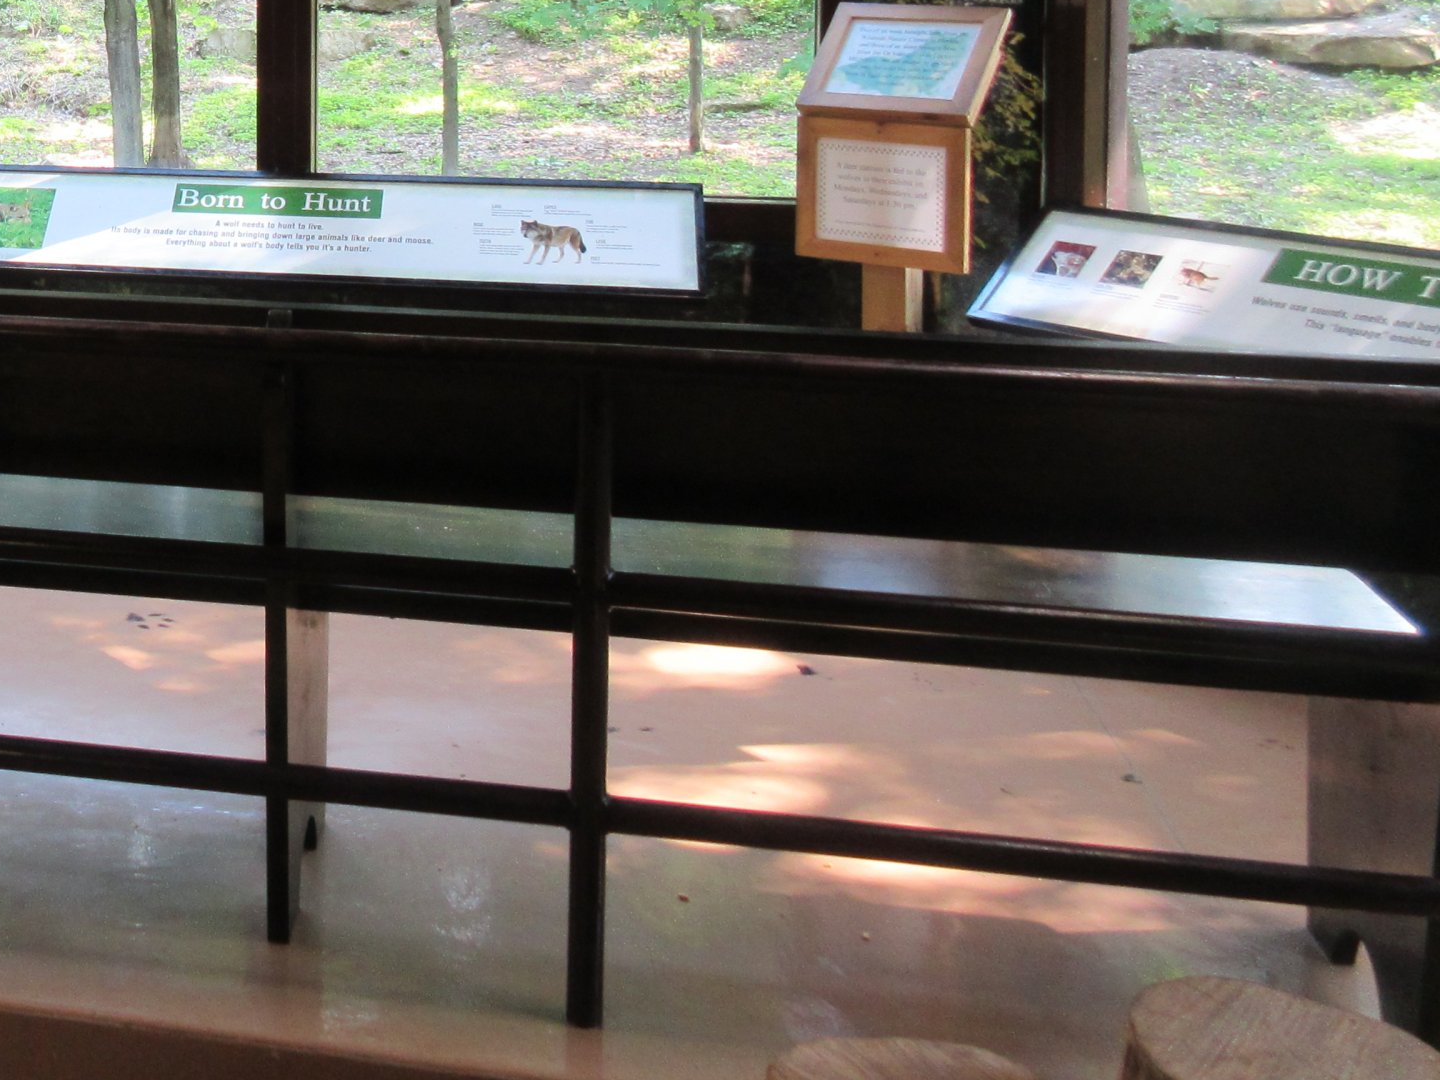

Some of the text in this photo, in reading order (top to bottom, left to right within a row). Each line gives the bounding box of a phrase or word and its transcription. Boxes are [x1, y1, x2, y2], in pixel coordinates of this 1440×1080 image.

[177, 188, 372, 213] Born to Hunt
[223, 219, 240, 227] wolf
[241, 220, 265, 228] needs
[267, 221, 275, 229] to
[277, 222, 296, 230] hunt
[298, 222, 306, 230] to
[307, 222, 324, 231] live.
[123, 226, 141, 235] body
[143, 226, 150, 234] is
[152, 227, 174, 235] made
[176, 228, 187, 236] for
[188, 228, 218, 238] chasing
[221, 230, 235, 238] and
[237, 230, 270, 240] bringing
[272, 232, 293, 240] down
[295, 233, 316, 242] large
[317, 233, 349, 242] animals
[350, 234, 366, 242] like
[367, 235, 386, 243] deer
[387, 236, 403, 244] and
[405, 237, 434, 245] moose.
[166, 238, 206, 248] Everything
[209, 239, 231, 248] about
[240, 240, 263, 249] wolf's
[265, 242, 285, 251] body
[286, 243, 304, 251] tells
[344, 244, 373, 253] hunter.
[1293, 259, 1404, 292] HOW
